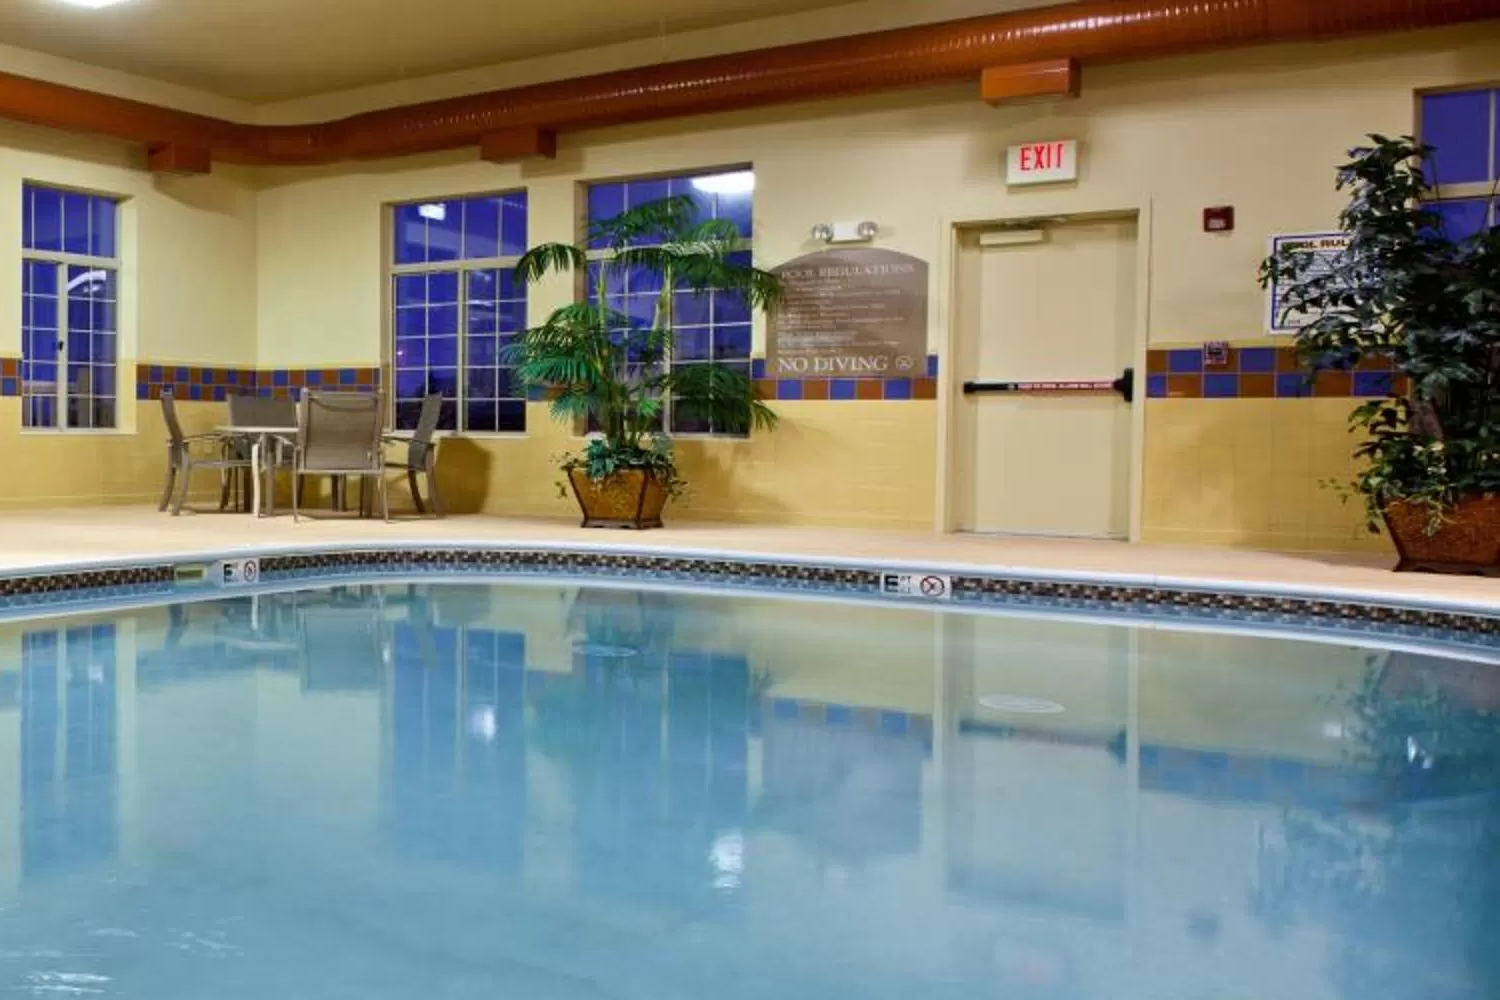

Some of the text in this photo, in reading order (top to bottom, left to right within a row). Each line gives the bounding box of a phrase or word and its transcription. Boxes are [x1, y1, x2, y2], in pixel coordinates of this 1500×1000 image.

[1020, 144, 1063, 170] EXIT
[778, 356, 888, 373] NO DIVING
